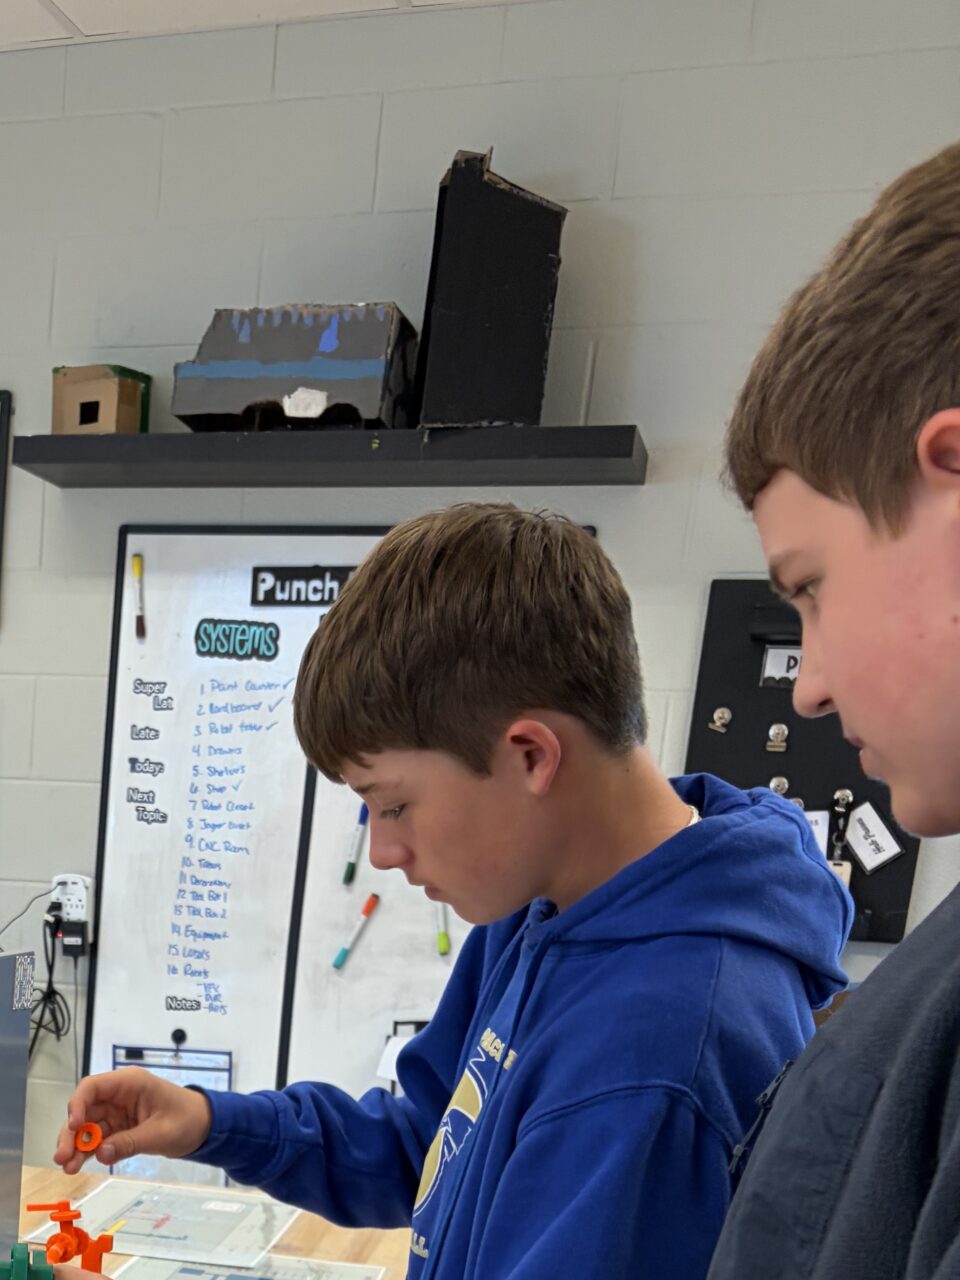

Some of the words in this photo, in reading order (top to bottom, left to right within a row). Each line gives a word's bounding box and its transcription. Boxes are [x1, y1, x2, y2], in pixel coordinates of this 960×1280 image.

[256, 571, 339, 601] Punch
[133, 680, 167, 695] Super
[127, 788, 155, 803] Next
